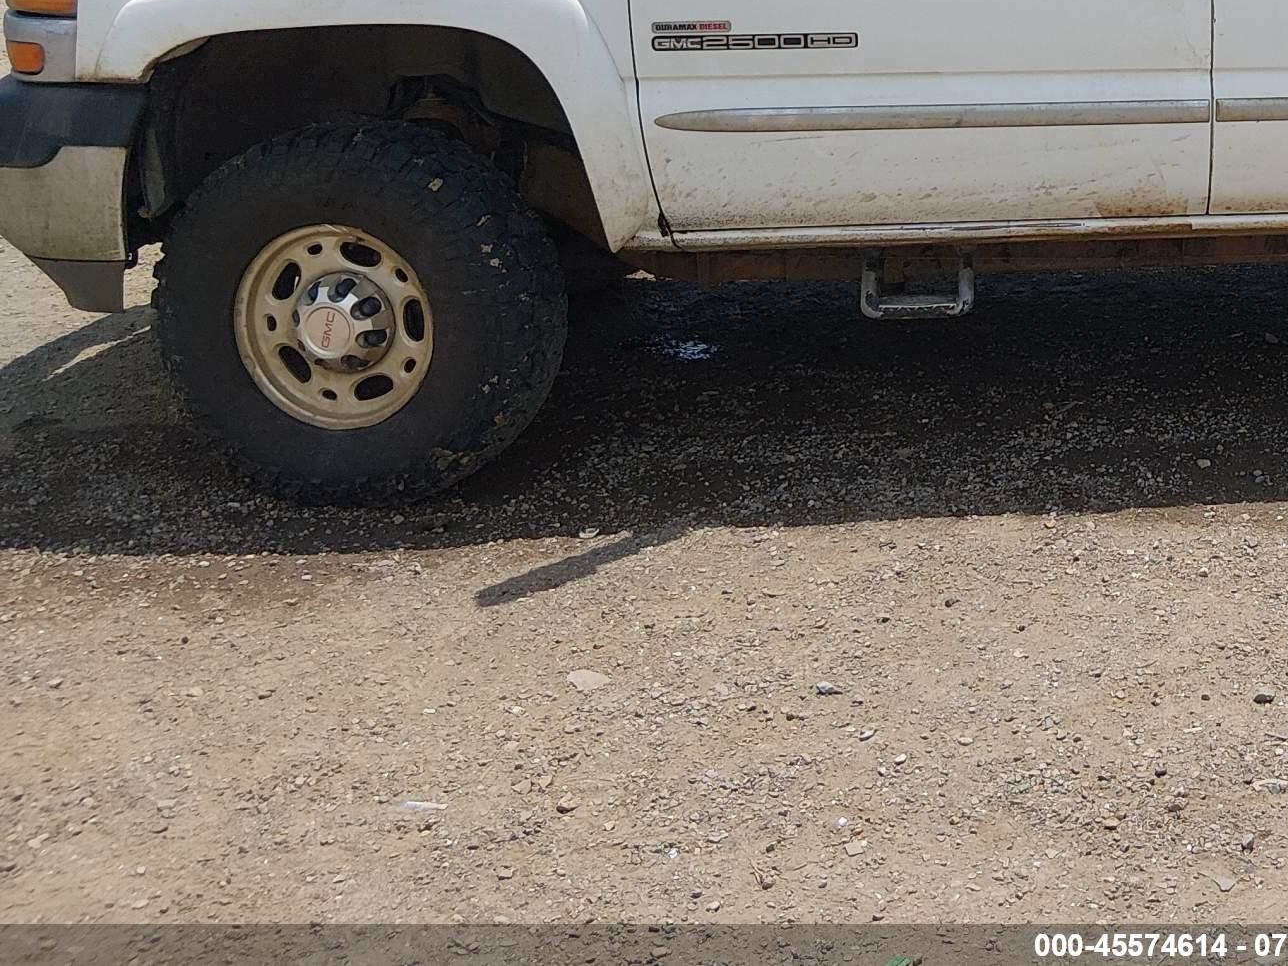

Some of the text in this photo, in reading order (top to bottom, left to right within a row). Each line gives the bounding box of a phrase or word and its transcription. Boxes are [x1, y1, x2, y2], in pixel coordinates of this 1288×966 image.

[654, 22, 729, 32] DURAMAX DIESEL
[320, 311, 336, 349] GMC
